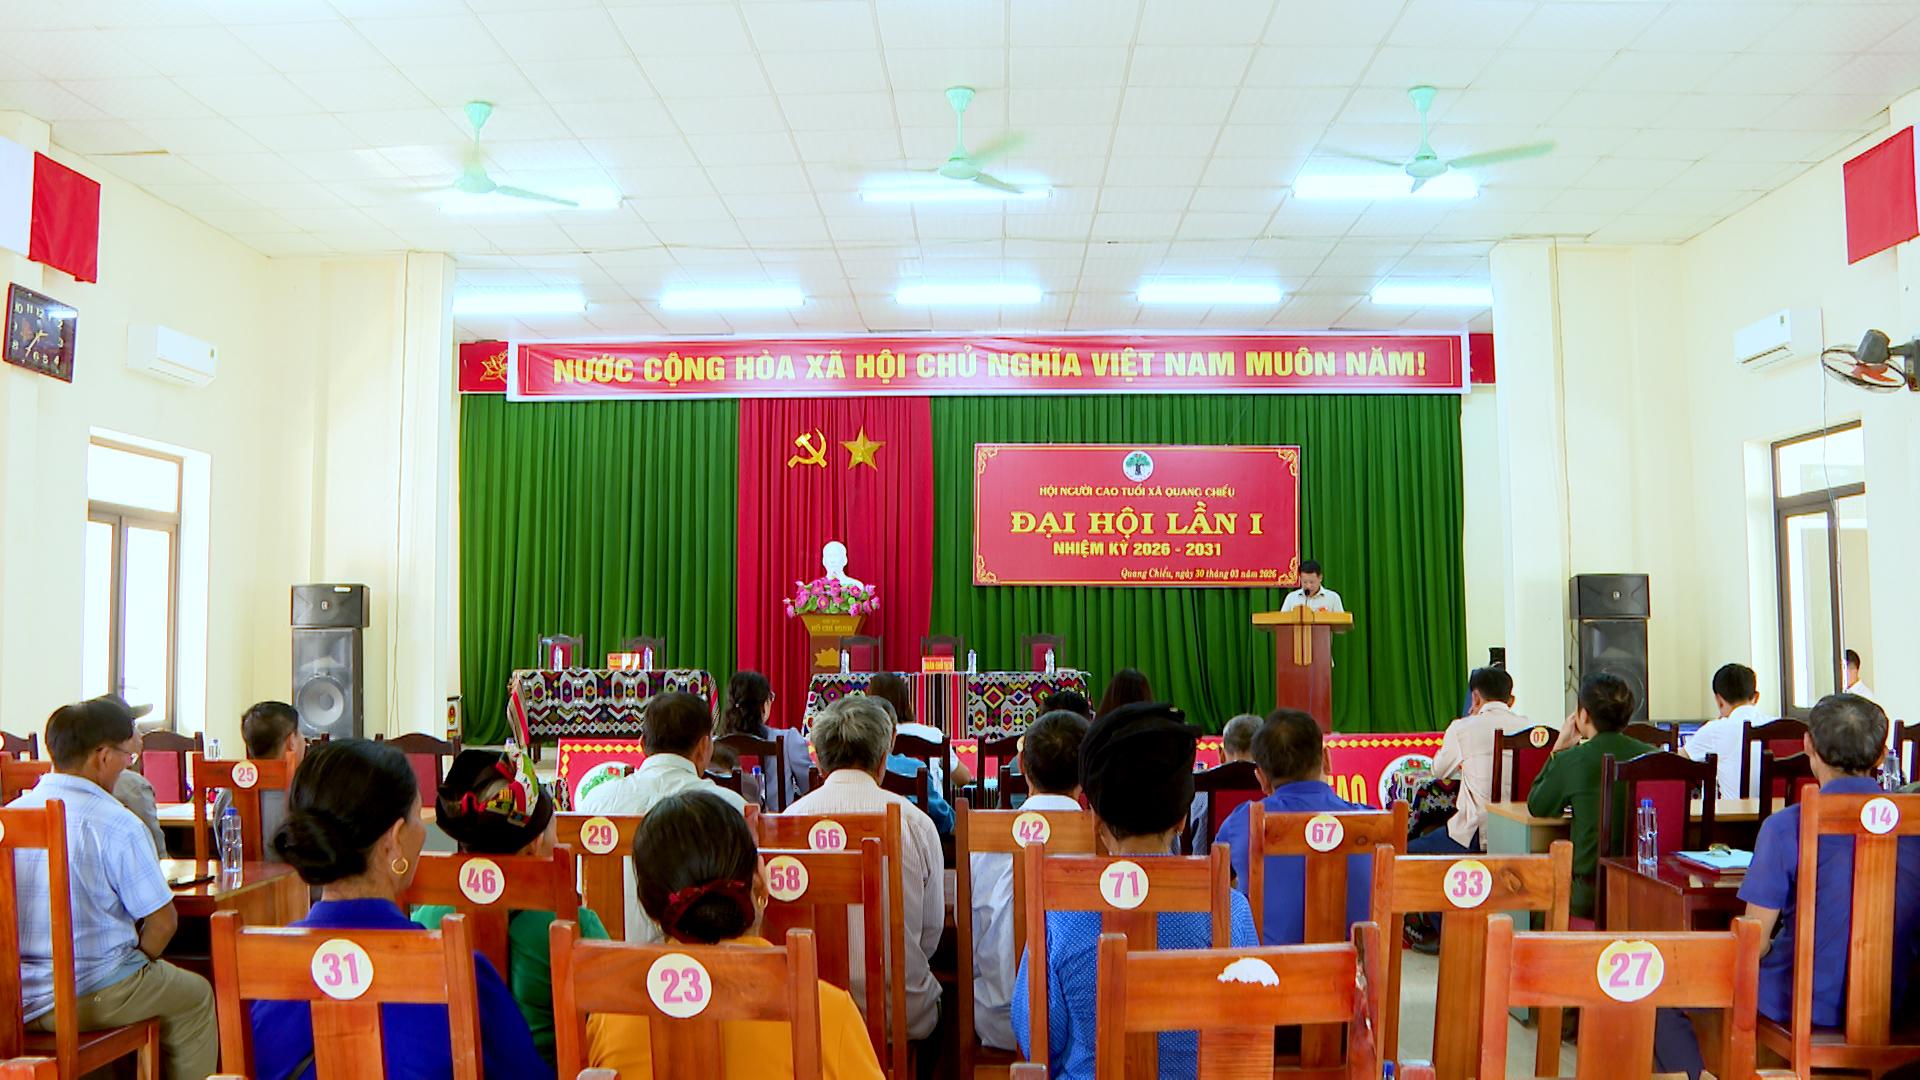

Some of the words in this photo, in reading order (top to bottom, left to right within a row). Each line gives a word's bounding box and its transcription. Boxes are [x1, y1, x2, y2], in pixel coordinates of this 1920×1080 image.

[553, 353, 634, 384] NƯỚC
[643, 351, 726, 388] CỘNG
[735, 348, 796, 380] HÒA
[805, 348, 846, 380] XÃ
[855, 348, 906, 385] HỘI
[916, 344, 978, 378] CHỦ
[987, 346, 1083, 378] NGHĨA
[1090, 346, 1156, 383] VIỆT
[1164, 351, 1236, 377] NAM
[1245, 346, 1336, 377] MUÔN
[1346, 346, 1427, 377] NĂM!
[1039, 483, 1058, 498] HỘI
[1060, 483, 1093, 497] NGƯỜI
[1095, 486, 1119, 497] CAO
[1121, 483, 1146, 497] TUỔI
[1148, 484, 1163, 497] XÃ
[1164, 486, 1202, 498] QUANG
[1010, 511, 1077, 539] ĐẠI
[1087, 506, 1155, 540] HỘI
[1166, 500, 1239, 535] LẦN
[1249, 512, 1264, 535] I
[1053, 539, 1105, 558] NHIỆM
[1108, 539, 1129, 556] KỲ
[1132, 542, 1171, 556] 2026
[1185, 542, 1222, 556] 2031
[1120, 567, 1147, 580] Quang
[1175, 568, 1194, 580] ngày
[1195, 568, 1205, 578] 30
[1205, 567, 1229, 580] tháng
[1230, 568, 1240, 578] 03
[1533, 731, 1546, 743] 07
[238, 767, 254, 782] 25
[1328, 774, 1368, 804] AO
[1868, 806, 1893, 826] 14
[588, 825, 612, 846] 29
[815, 829, 841, 849] 66
[1019, 820, 1044, 841] 42
[1311, 823, 1337, 844] 67
[467, 867, 496, 894] 46
[770, 865, 800, 892] 58
[1108, 871, 1141, 899] 71
[1452, 870, 1484, 898] 33
[321, 953, 359, 986] 31
[1609, 951, 1653, 988] 27
[660, 967, 704, 1004] 23
